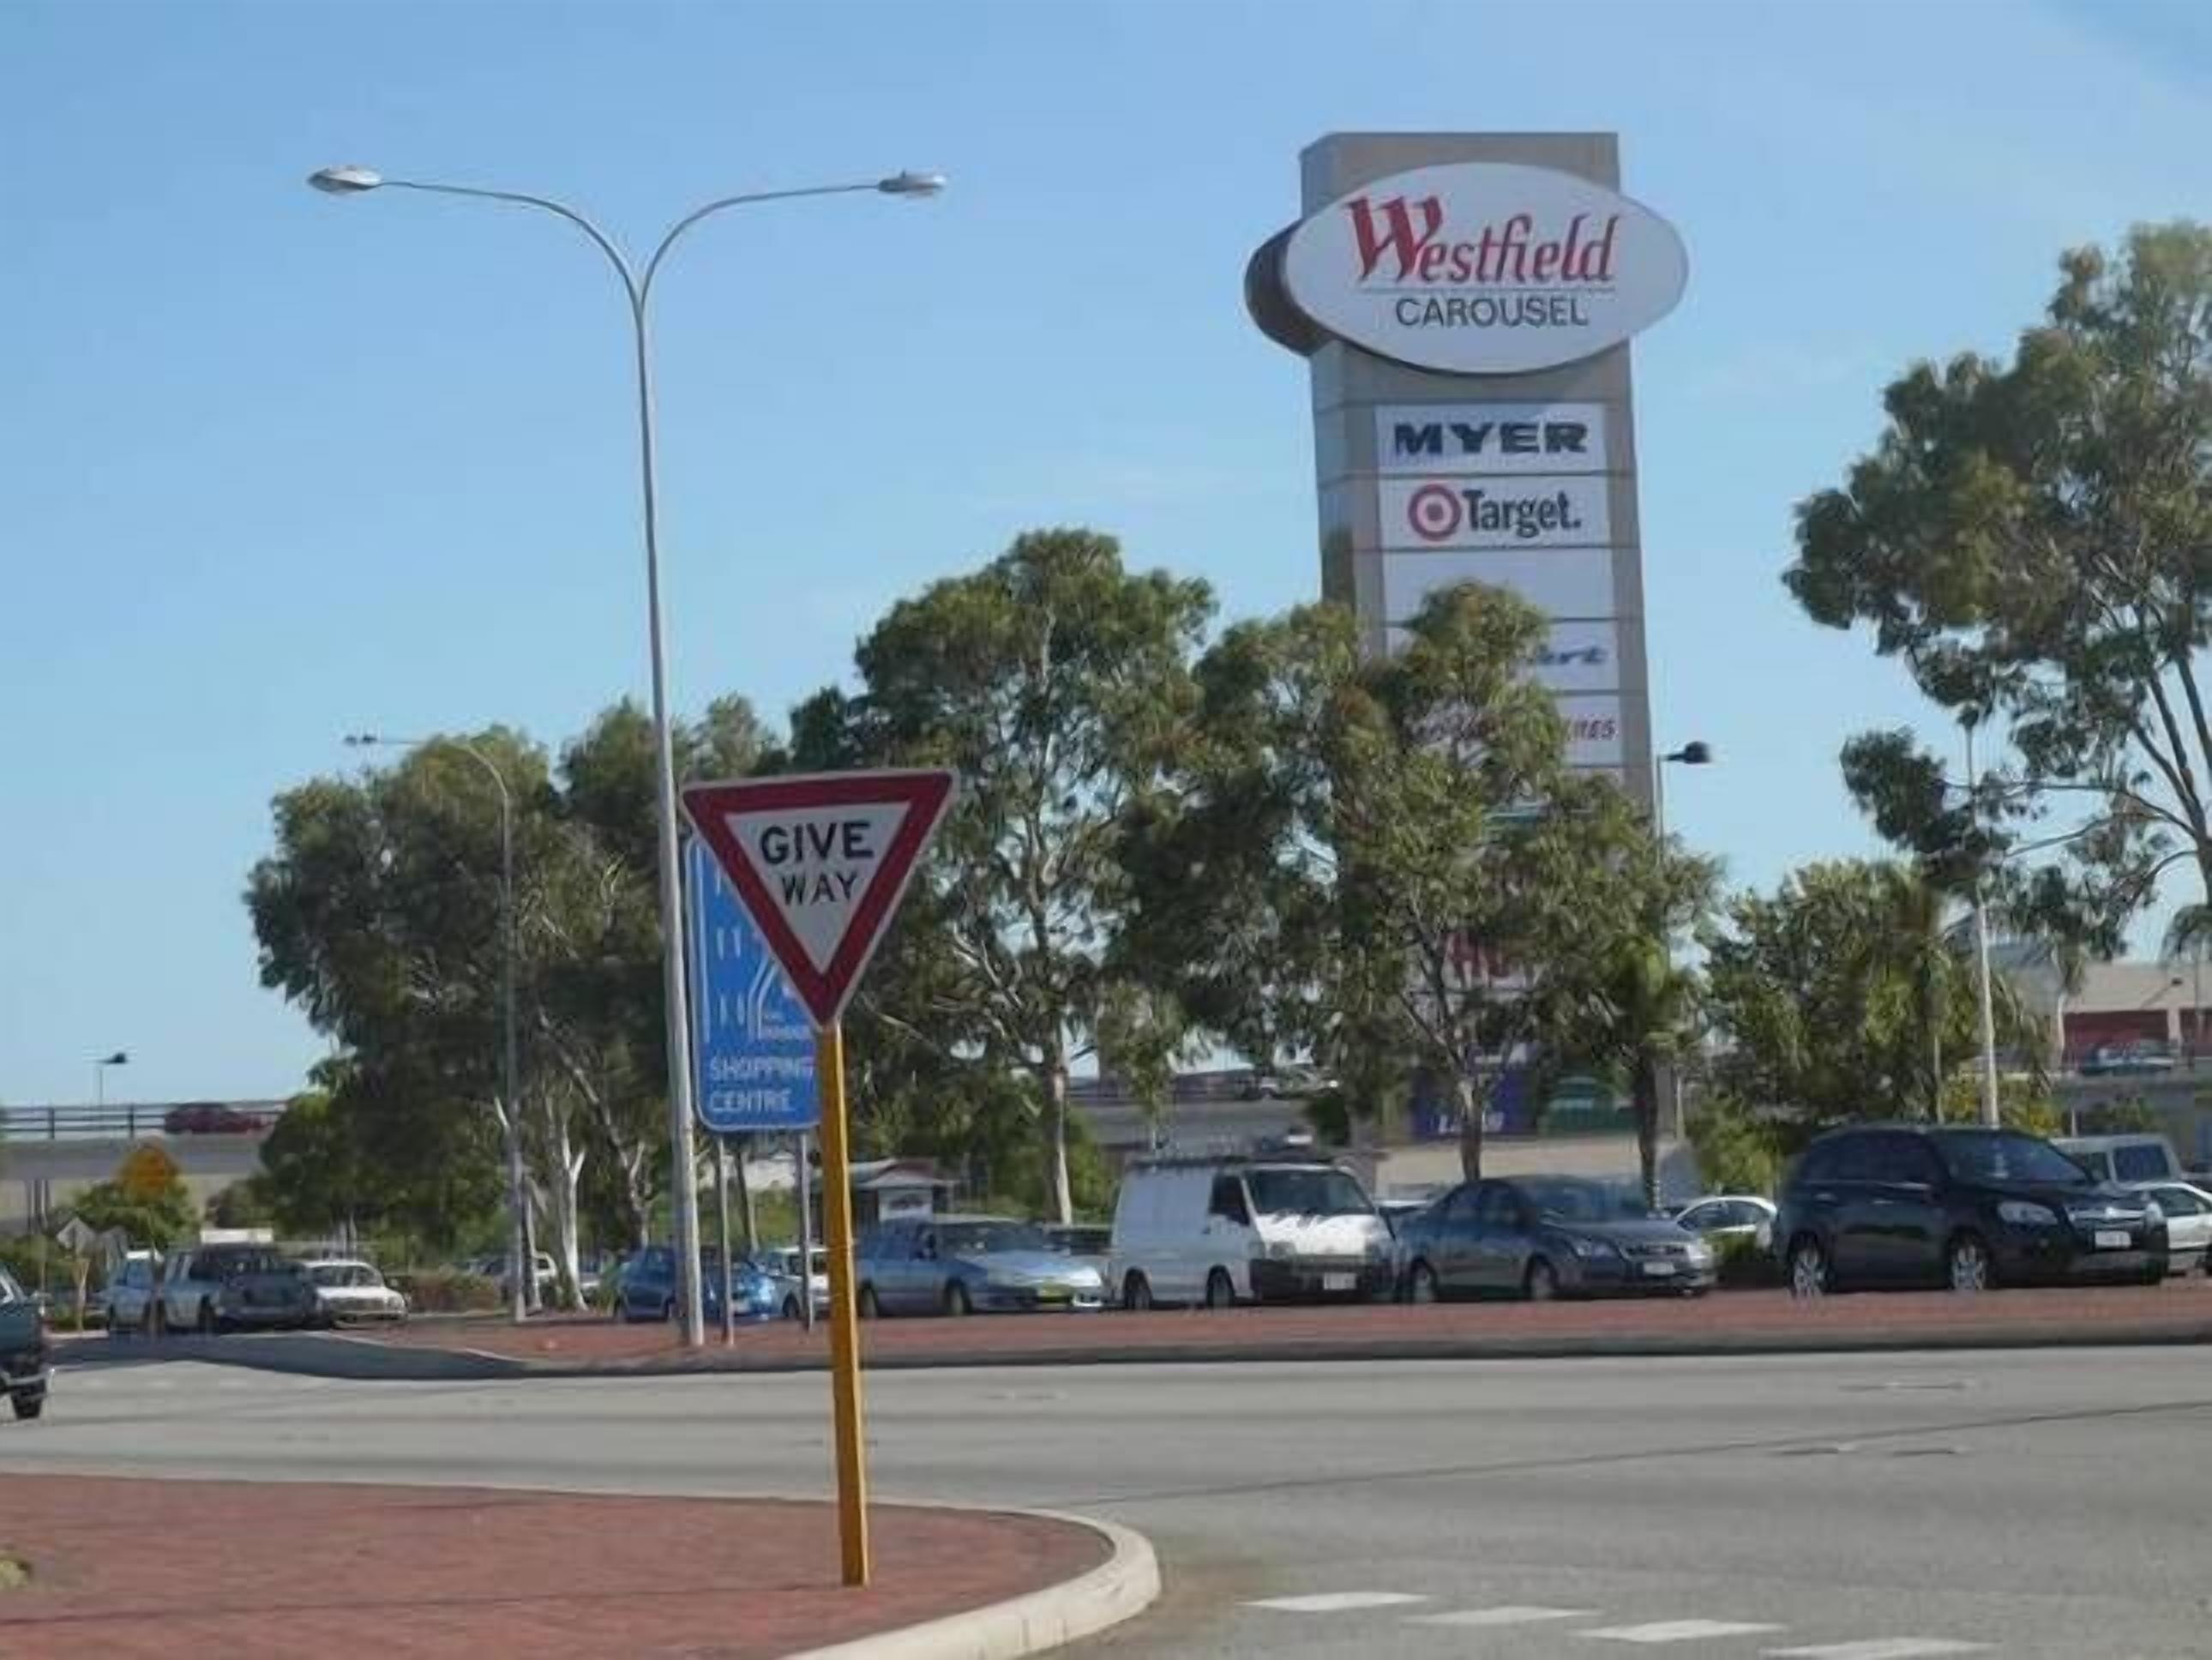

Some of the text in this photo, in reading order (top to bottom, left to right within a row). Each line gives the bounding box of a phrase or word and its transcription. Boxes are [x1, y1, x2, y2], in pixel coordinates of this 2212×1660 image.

[1343, 195, 1620, 285] Westfield
[1394, 297, 1589, 328] CAROUSEL
[1393, 423, 1589, 455] MYER
[760, 820, 875, 865] GIVE
[781, 871, 857, 906] WAY
[708, 1089, 796, 1113] CENTRE
